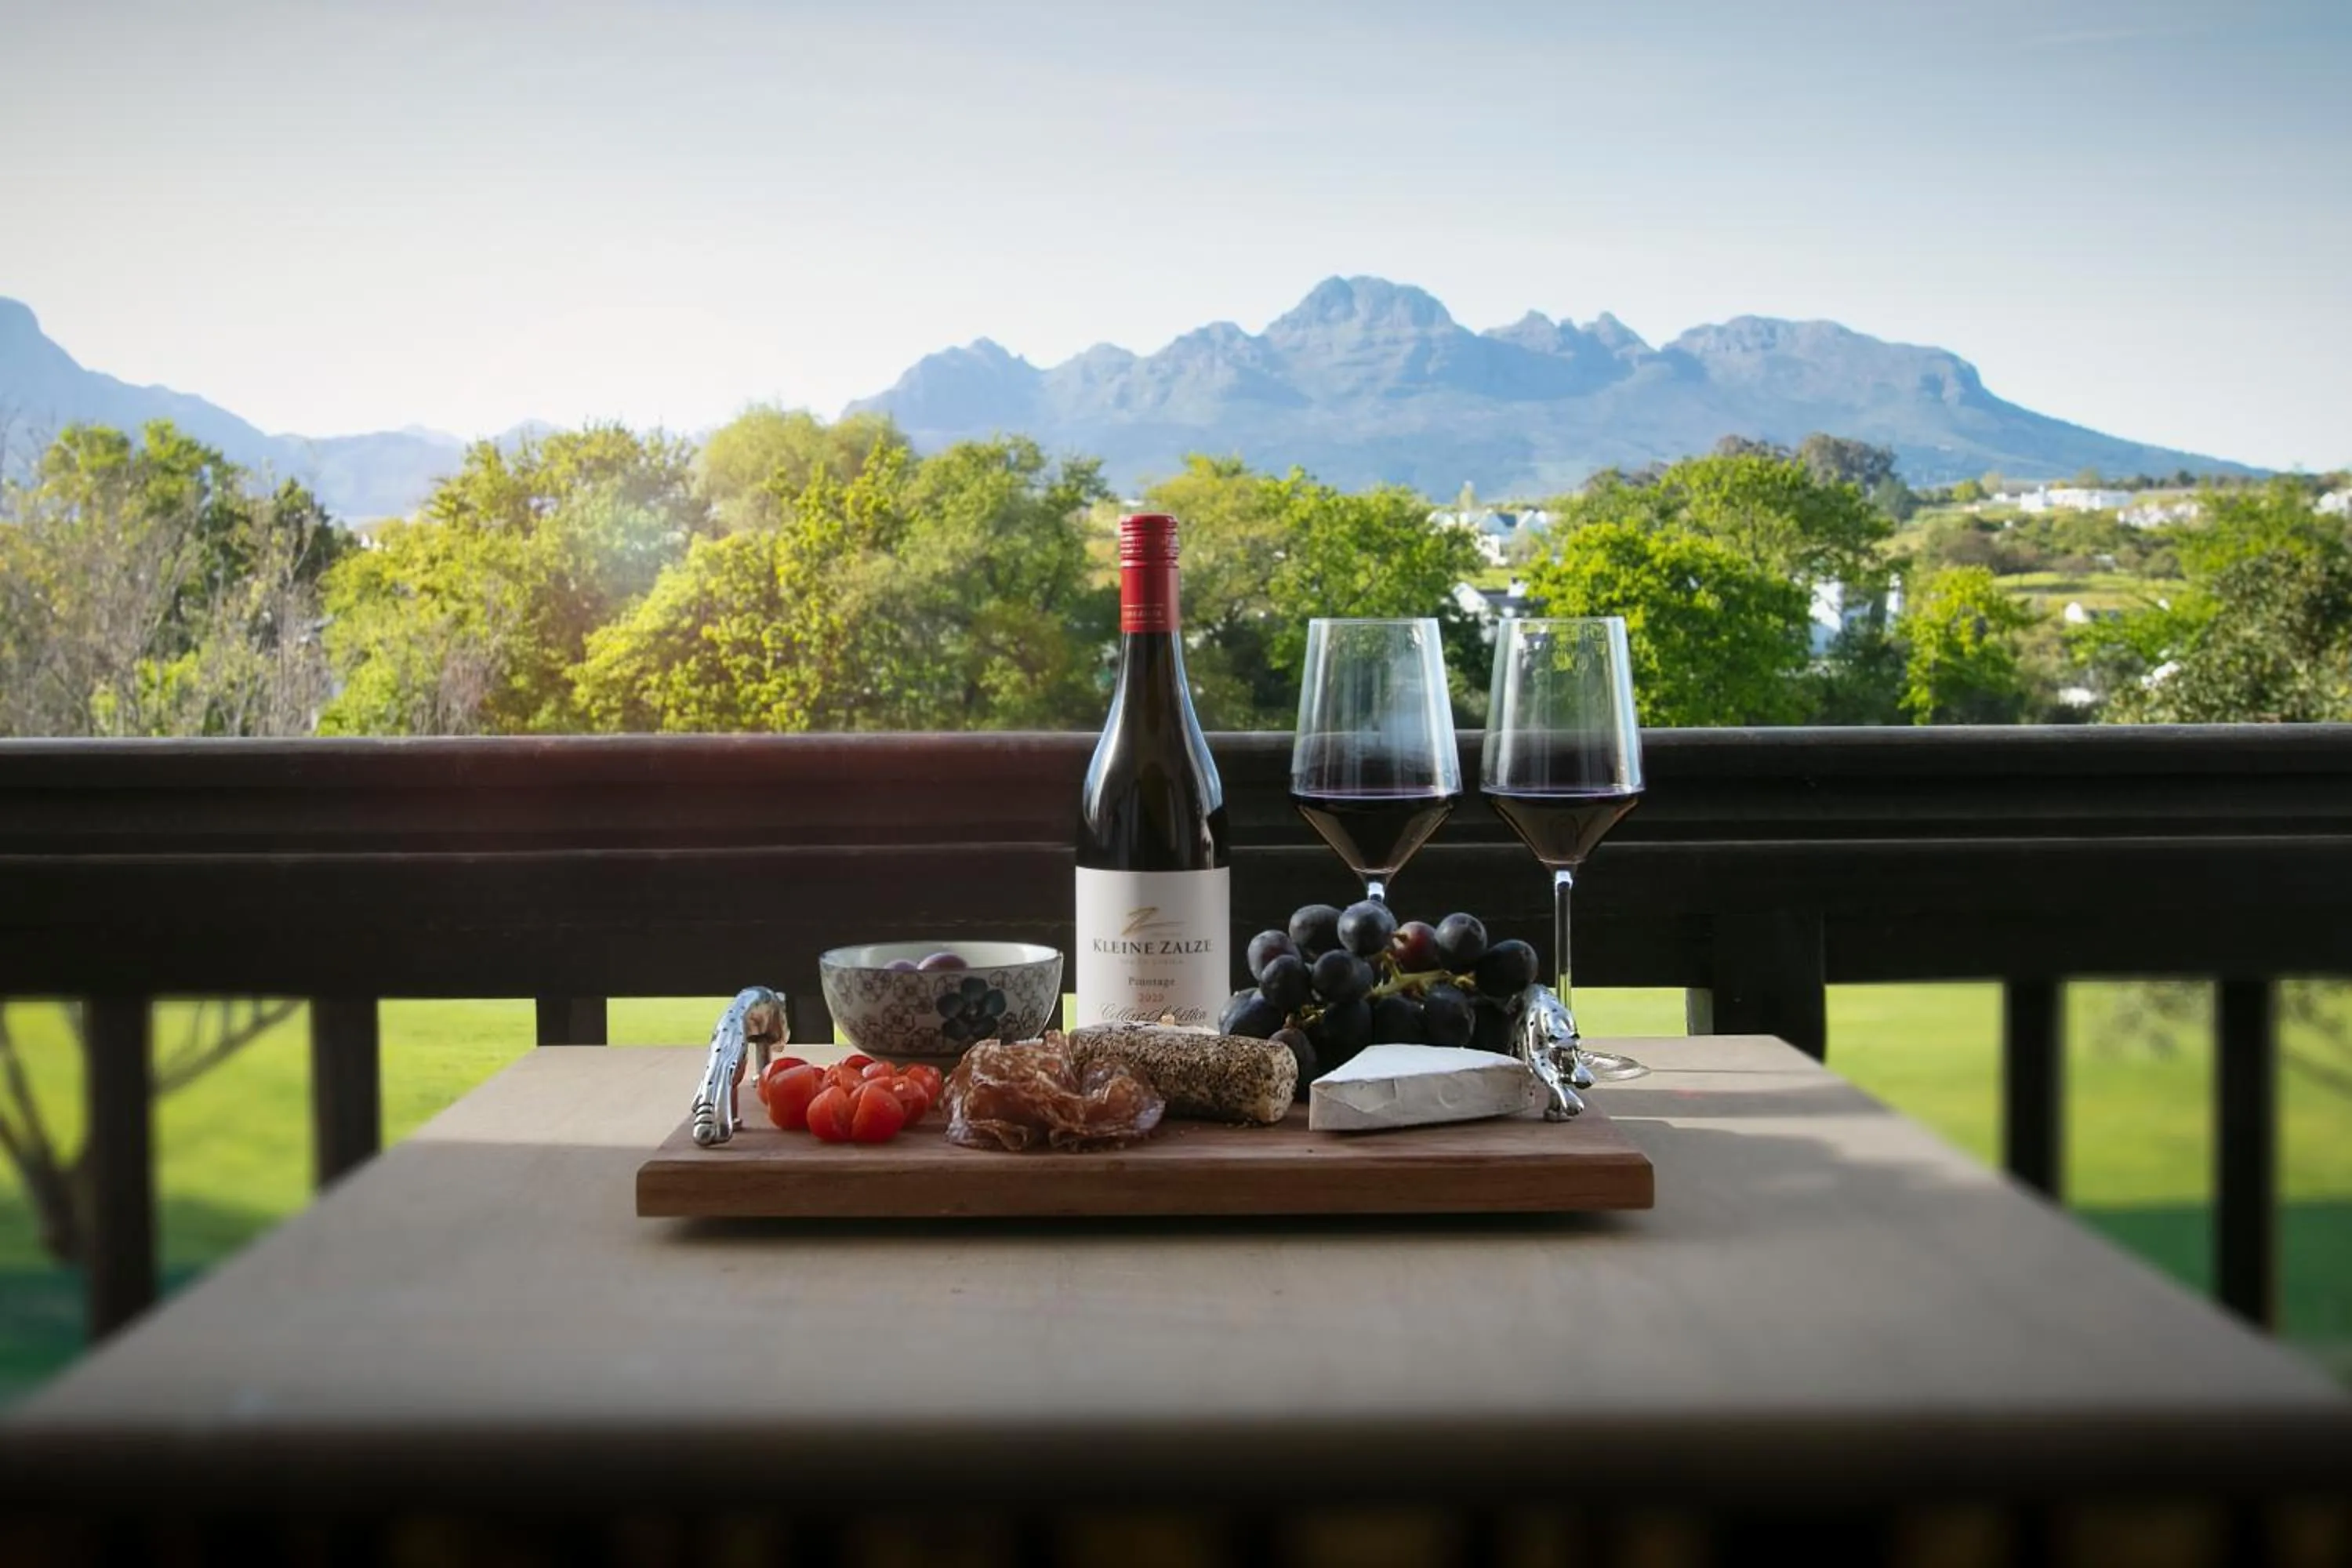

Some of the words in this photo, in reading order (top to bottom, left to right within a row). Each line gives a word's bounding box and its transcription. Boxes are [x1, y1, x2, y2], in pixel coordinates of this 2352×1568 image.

[1093, 938, 1154, 955] KLEINE
[1160, 938, 1214, 955] ZALZE
[1127, 976, 1176, 989] Pinotage
